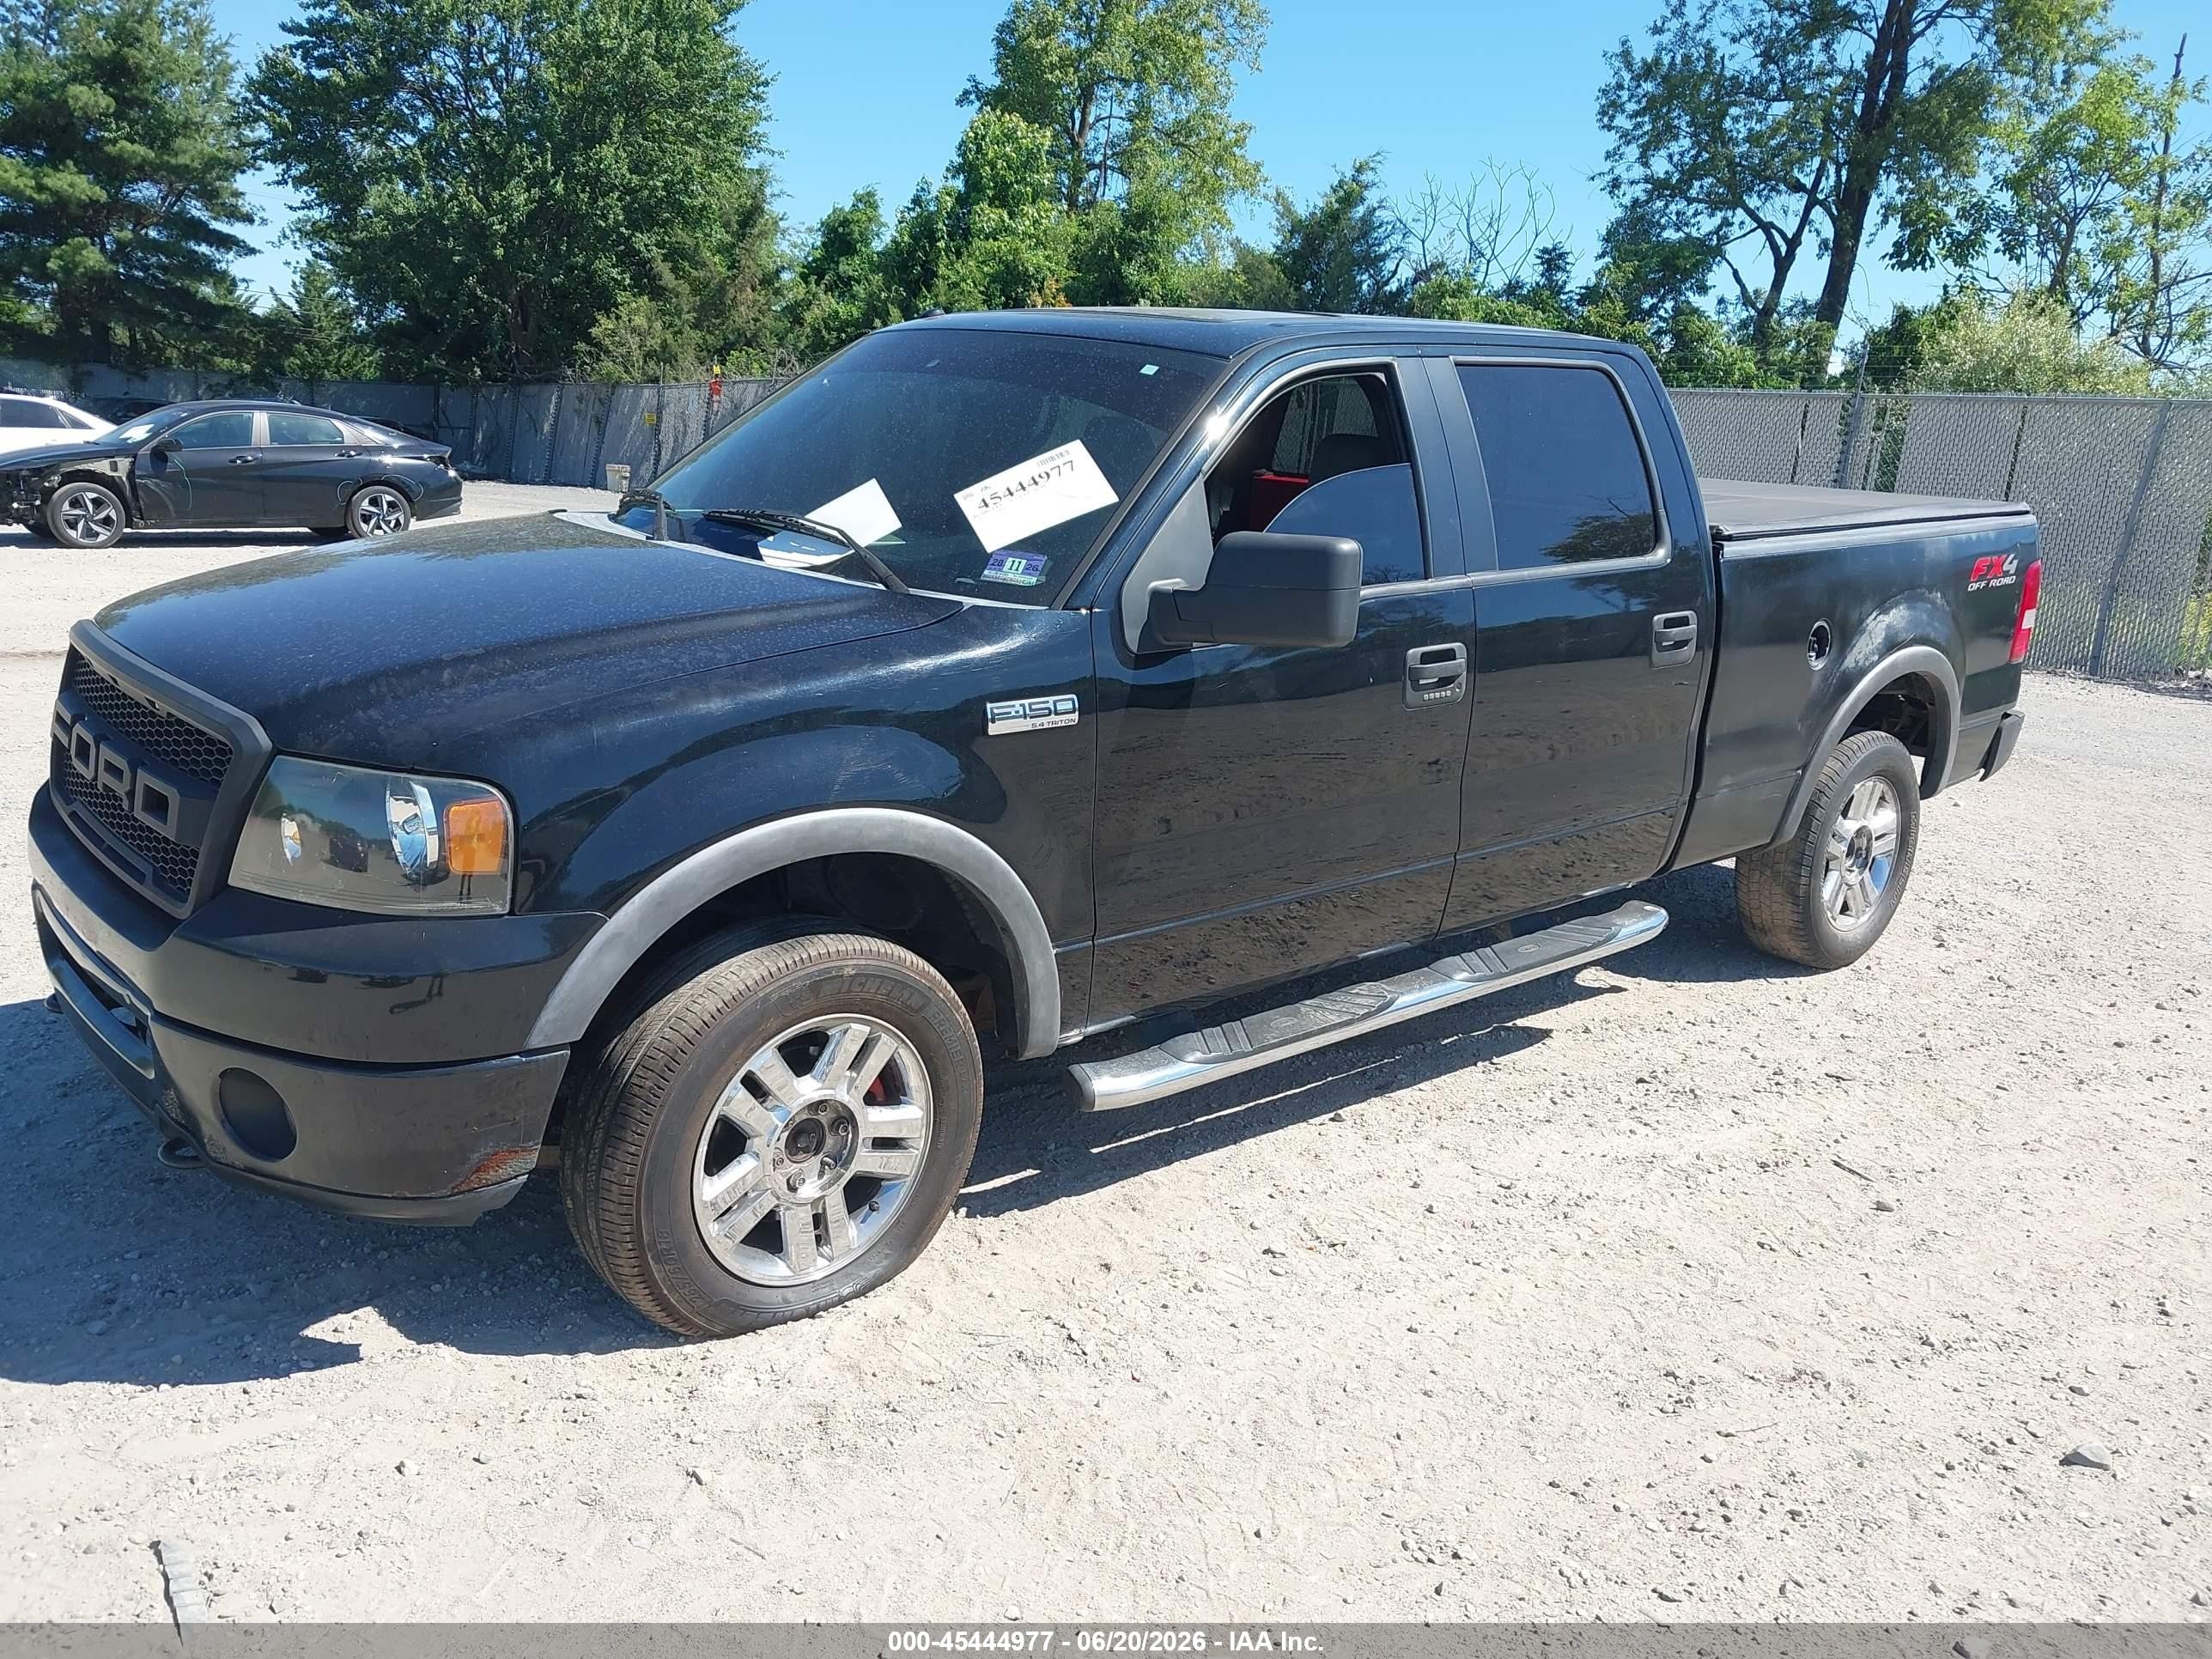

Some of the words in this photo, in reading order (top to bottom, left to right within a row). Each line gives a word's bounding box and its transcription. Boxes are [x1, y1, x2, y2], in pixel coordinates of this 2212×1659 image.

[977, 459, 1074, 509] 45444977
[990, 558, 1005, 568] 20
[1007, 559, 1022, 572] 11
[1025, 563, 1040, 572] 26
[1970, 553, 2019, 581] FX4
[1967, 580, 1987, 592] OFF
[1989, 575, 2016, 588] ROAD
[989, 697, 1078, 725] F-150
[1046, 718, 1076, 727] TRITON
[50, 698, 180, 840] FORD
